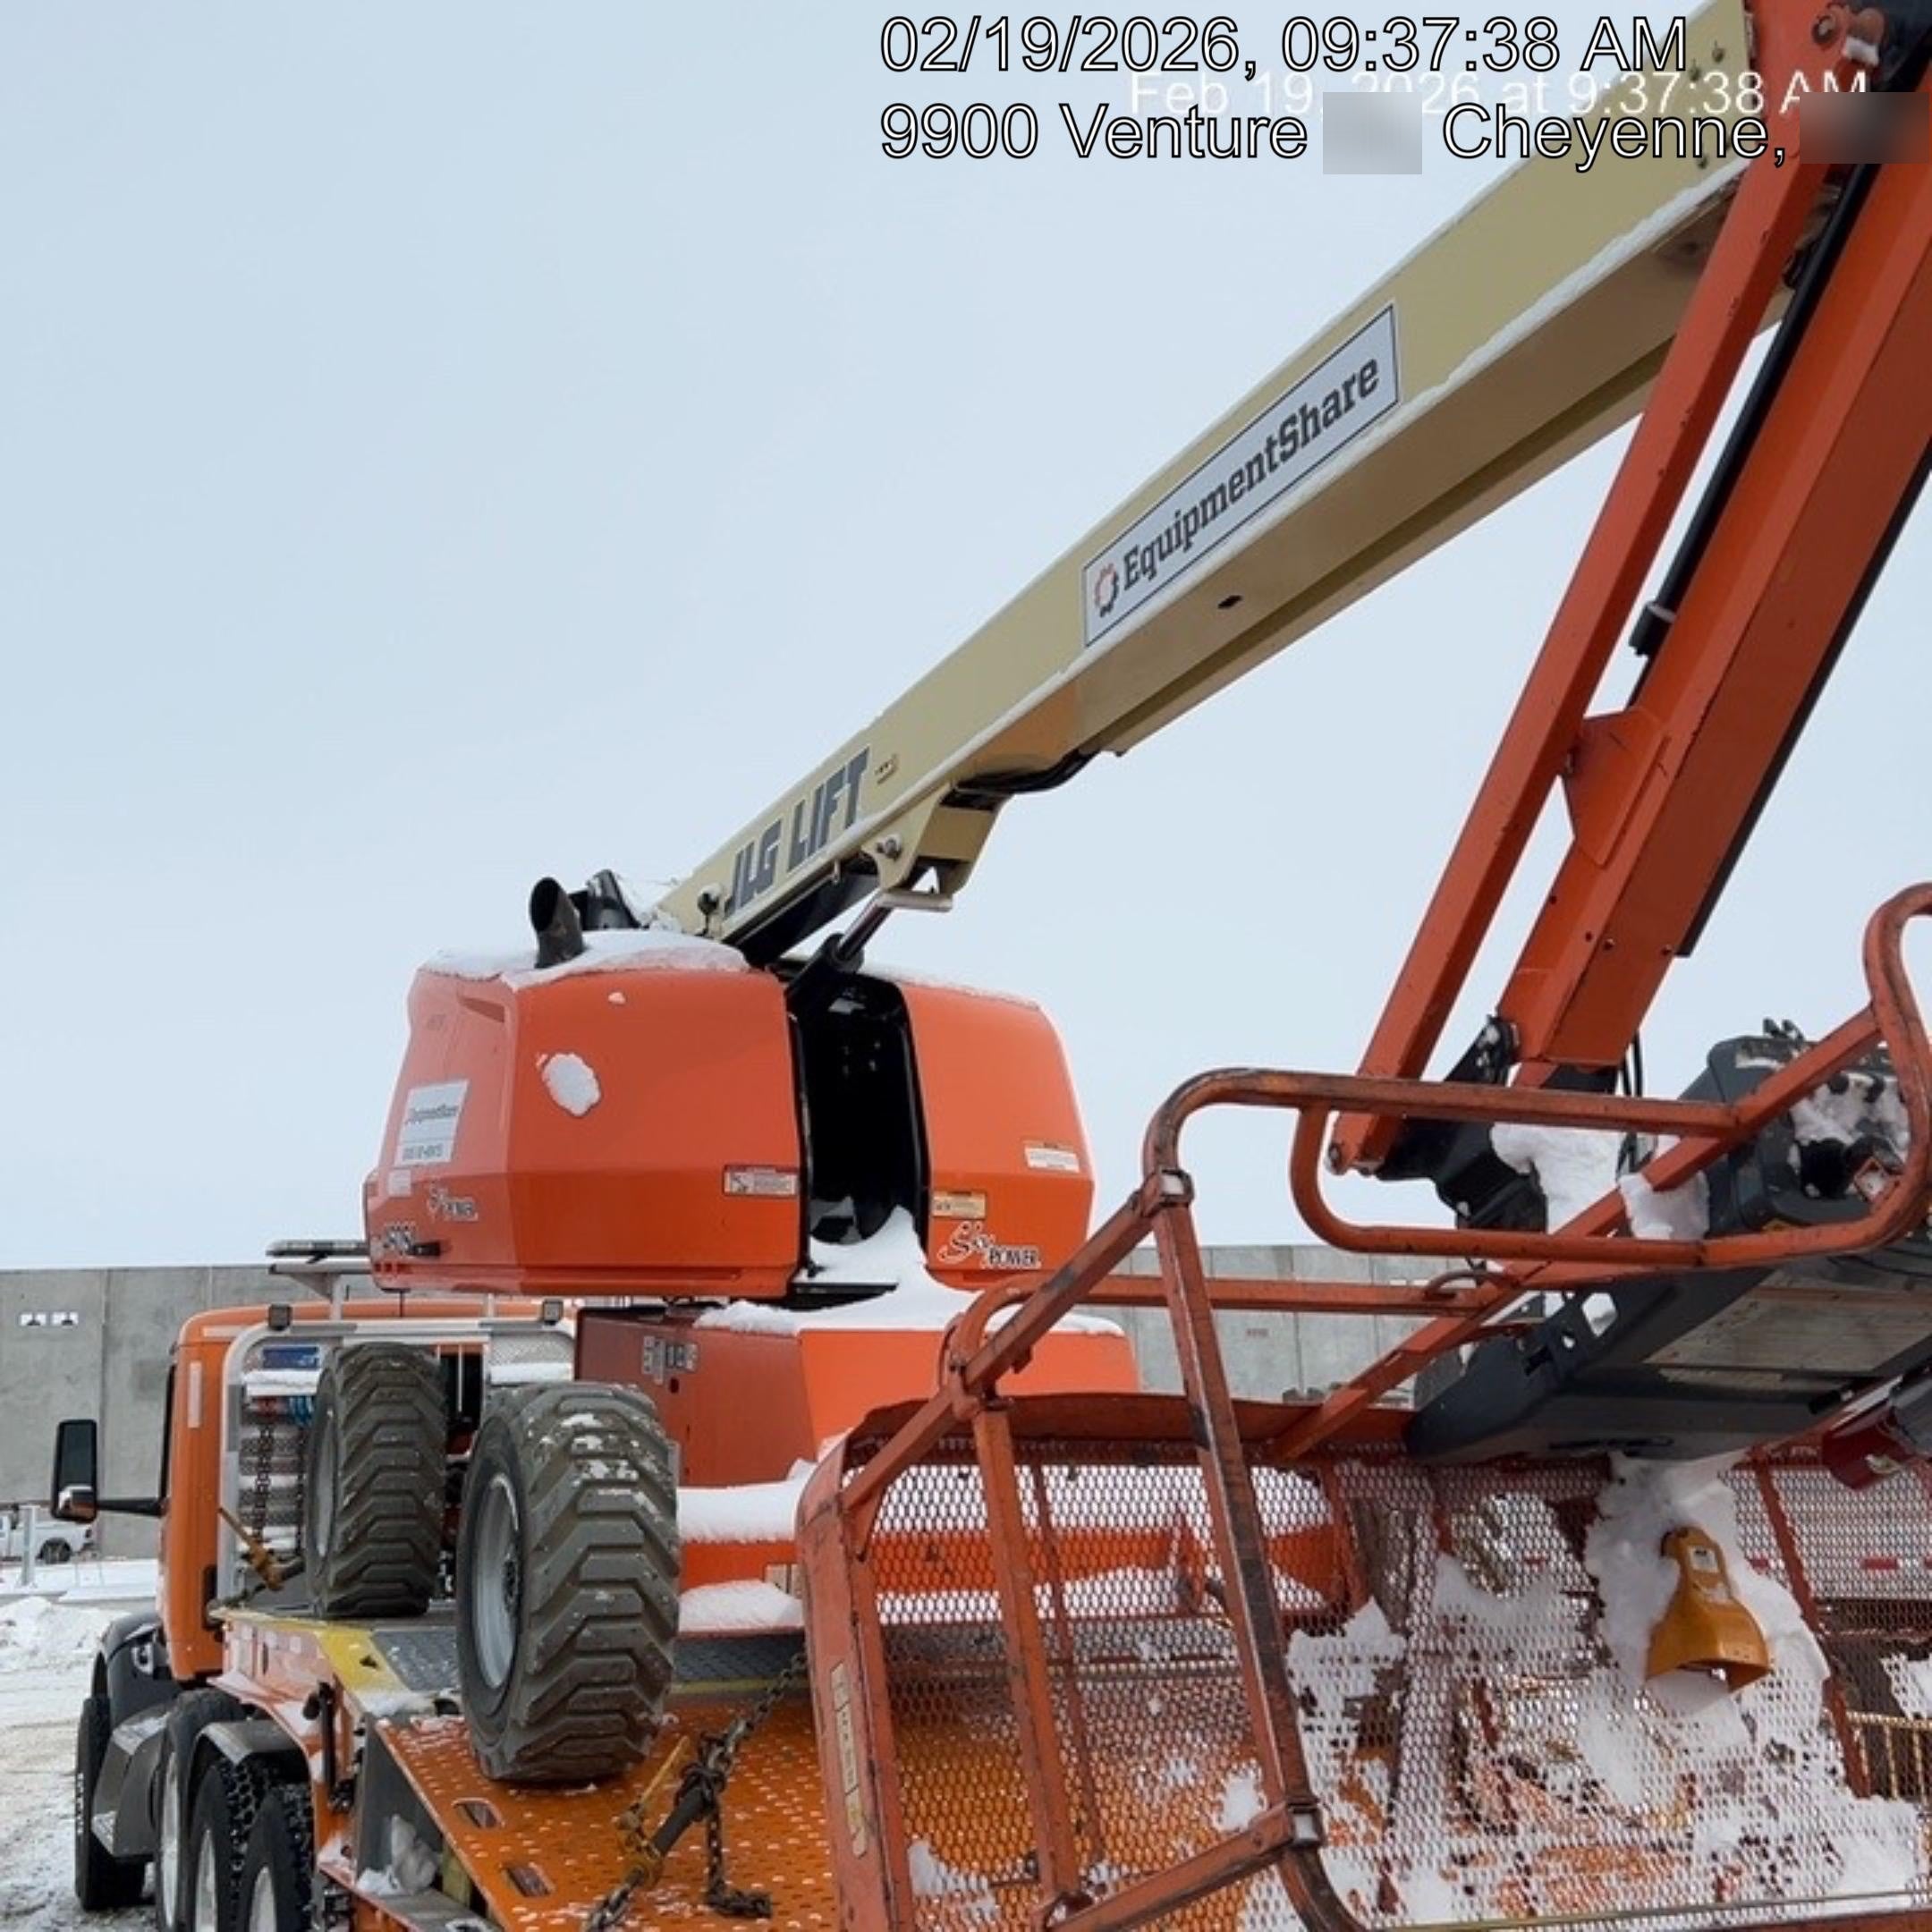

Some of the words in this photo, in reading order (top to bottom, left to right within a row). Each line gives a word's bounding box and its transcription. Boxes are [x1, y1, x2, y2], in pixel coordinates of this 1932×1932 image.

[1123, 358, 1379, 591] EquipmentShare
[724, 818, 782, 919] JLG
[787, 744, 870, 874] LIFT
